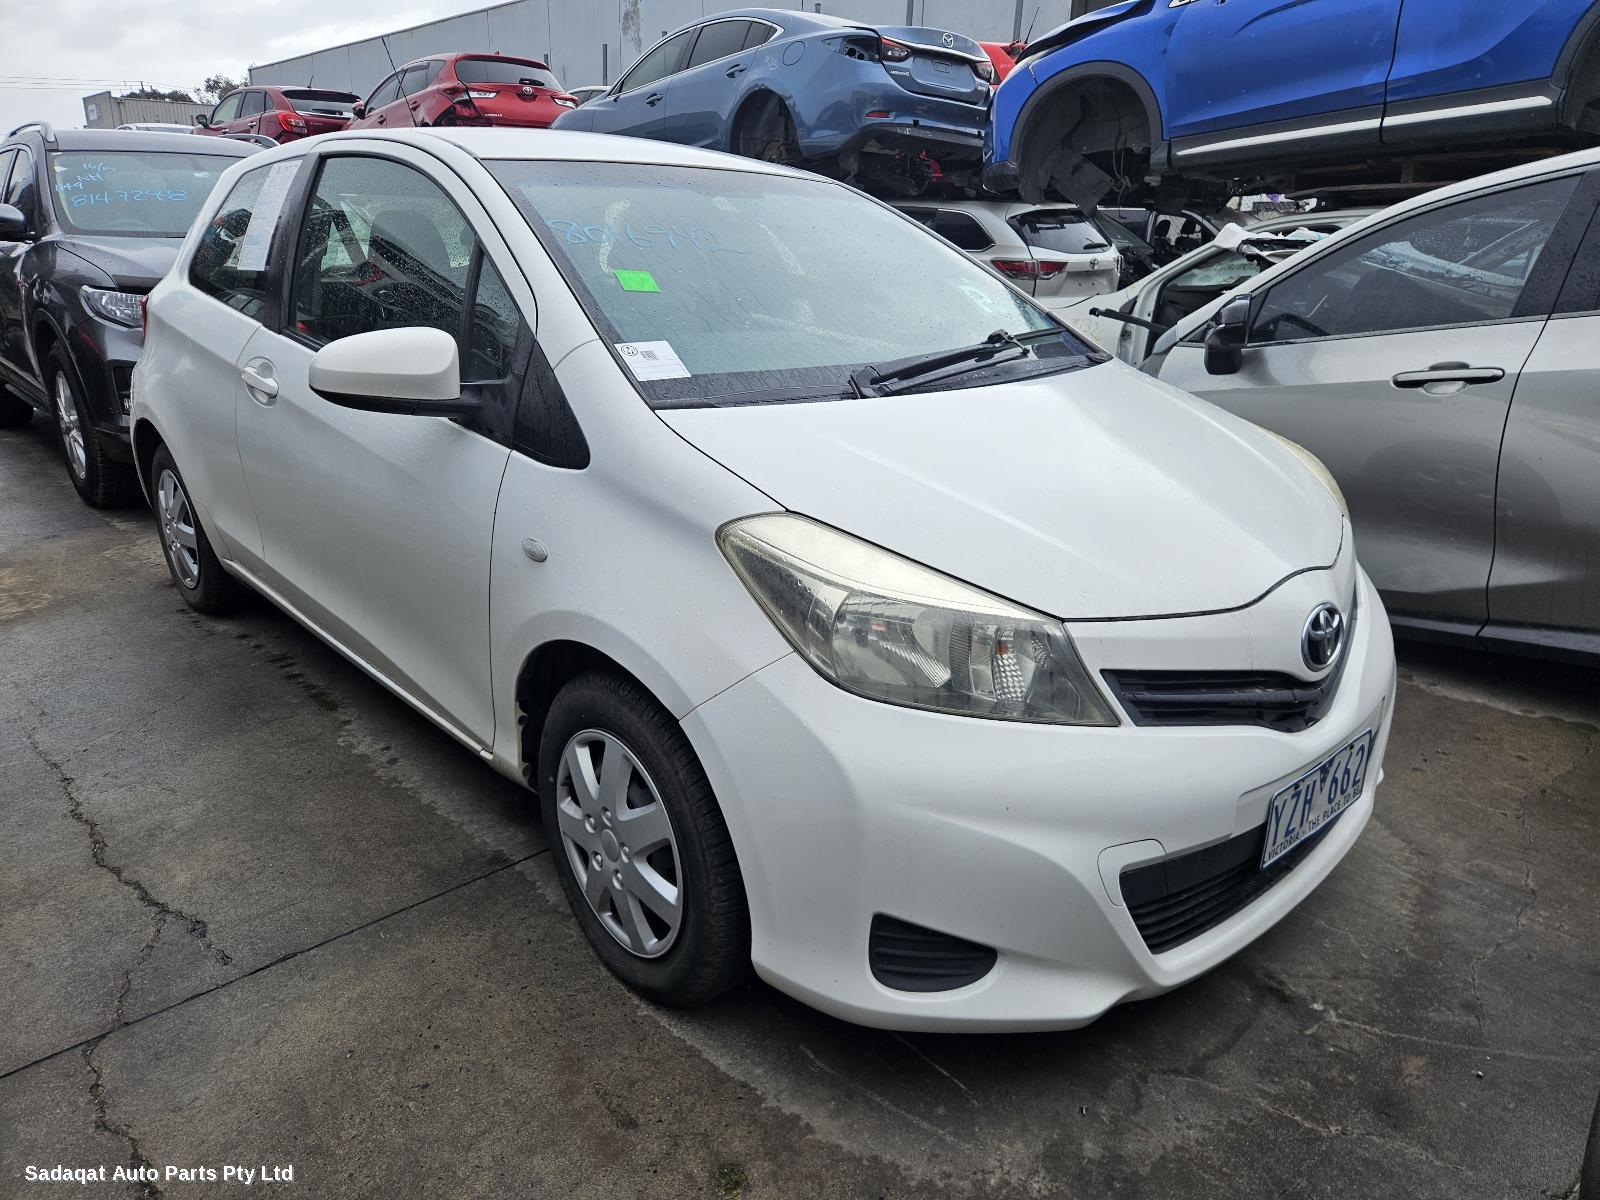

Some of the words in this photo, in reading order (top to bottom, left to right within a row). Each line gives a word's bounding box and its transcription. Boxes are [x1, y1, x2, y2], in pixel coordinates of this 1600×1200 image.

[1268, 831, 1300, 861] VICTORIA
[1308, 815, 1321, 830] THE
[1323, 799, 1341, 819] PLACE
[1343, 793, 1351, 807] TO
[1352, 785, 1361, 798] BE
[1271, 779, 1317, 847] YZH
[1327, 743, 1366, 805] 662
